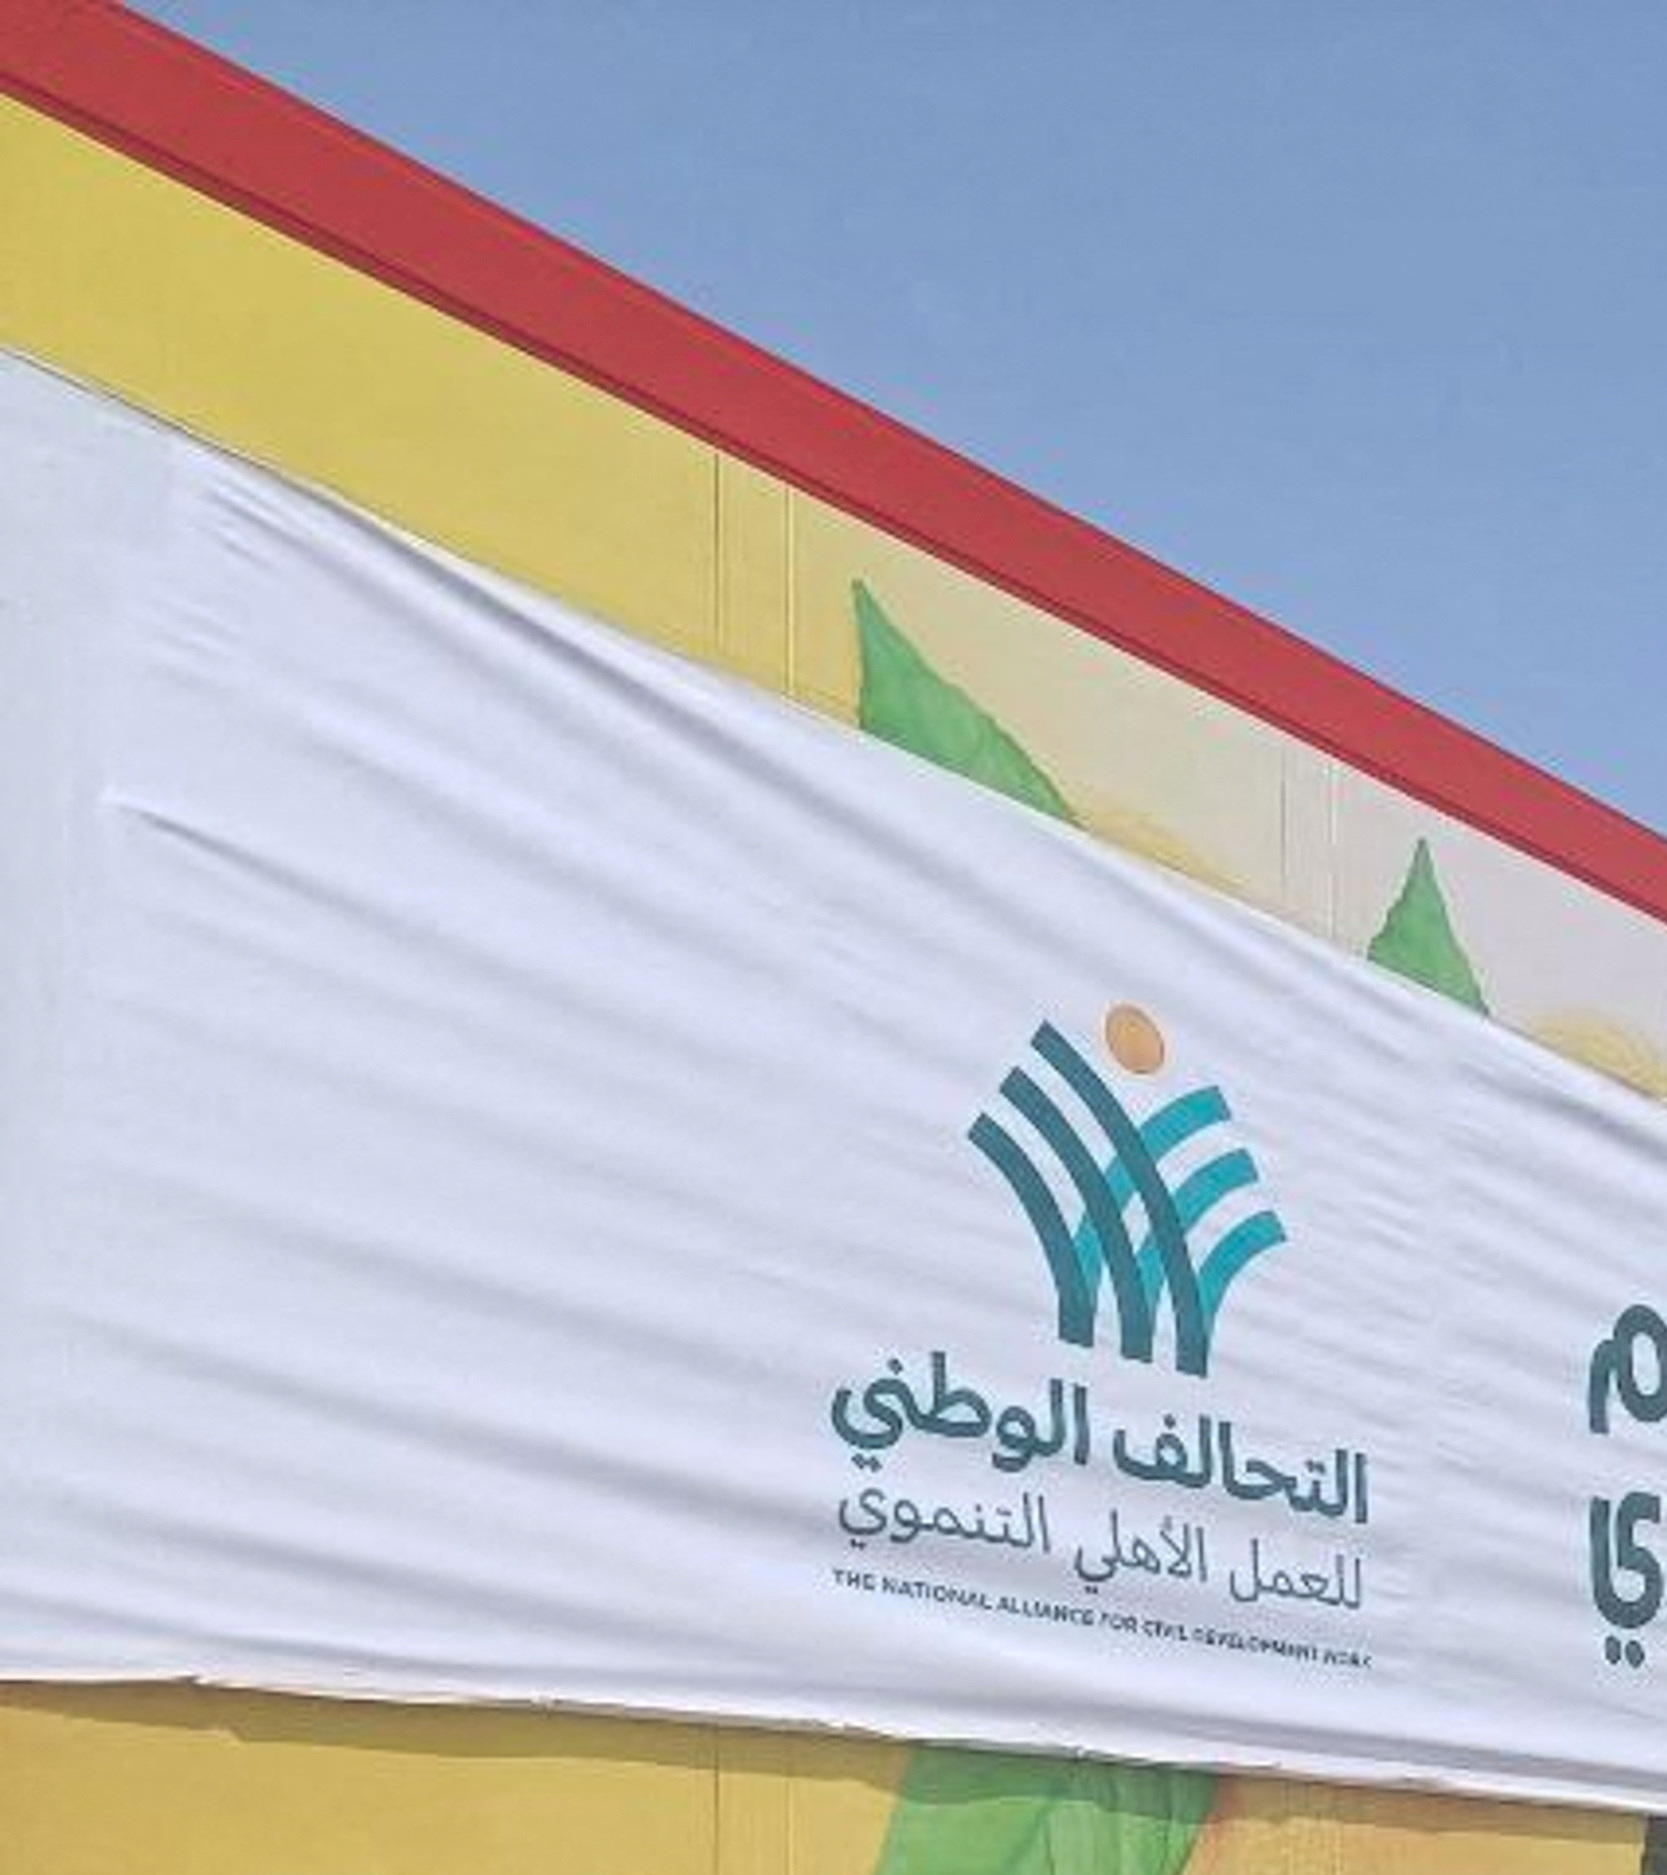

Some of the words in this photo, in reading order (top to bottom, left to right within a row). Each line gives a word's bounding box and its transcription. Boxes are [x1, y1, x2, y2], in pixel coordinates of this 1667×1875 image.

[831, 1351, 1089, 1473] الوطني
[1113, 1413, 1368, 1524] التحالف
[838, 1486, 1051, 1552] التنموي
[1073, 1509, 1208, 1595] الأهلي
[833, 1569, 876, 1591] THE
[882, 1577, 993, 1611] NATIONAL
[997, 1597, 1095, 1627] ALLIANCE
[1100, 1608, 1138, 1634] FOR
[1229, 1537, 1364, 1610] للعمل
